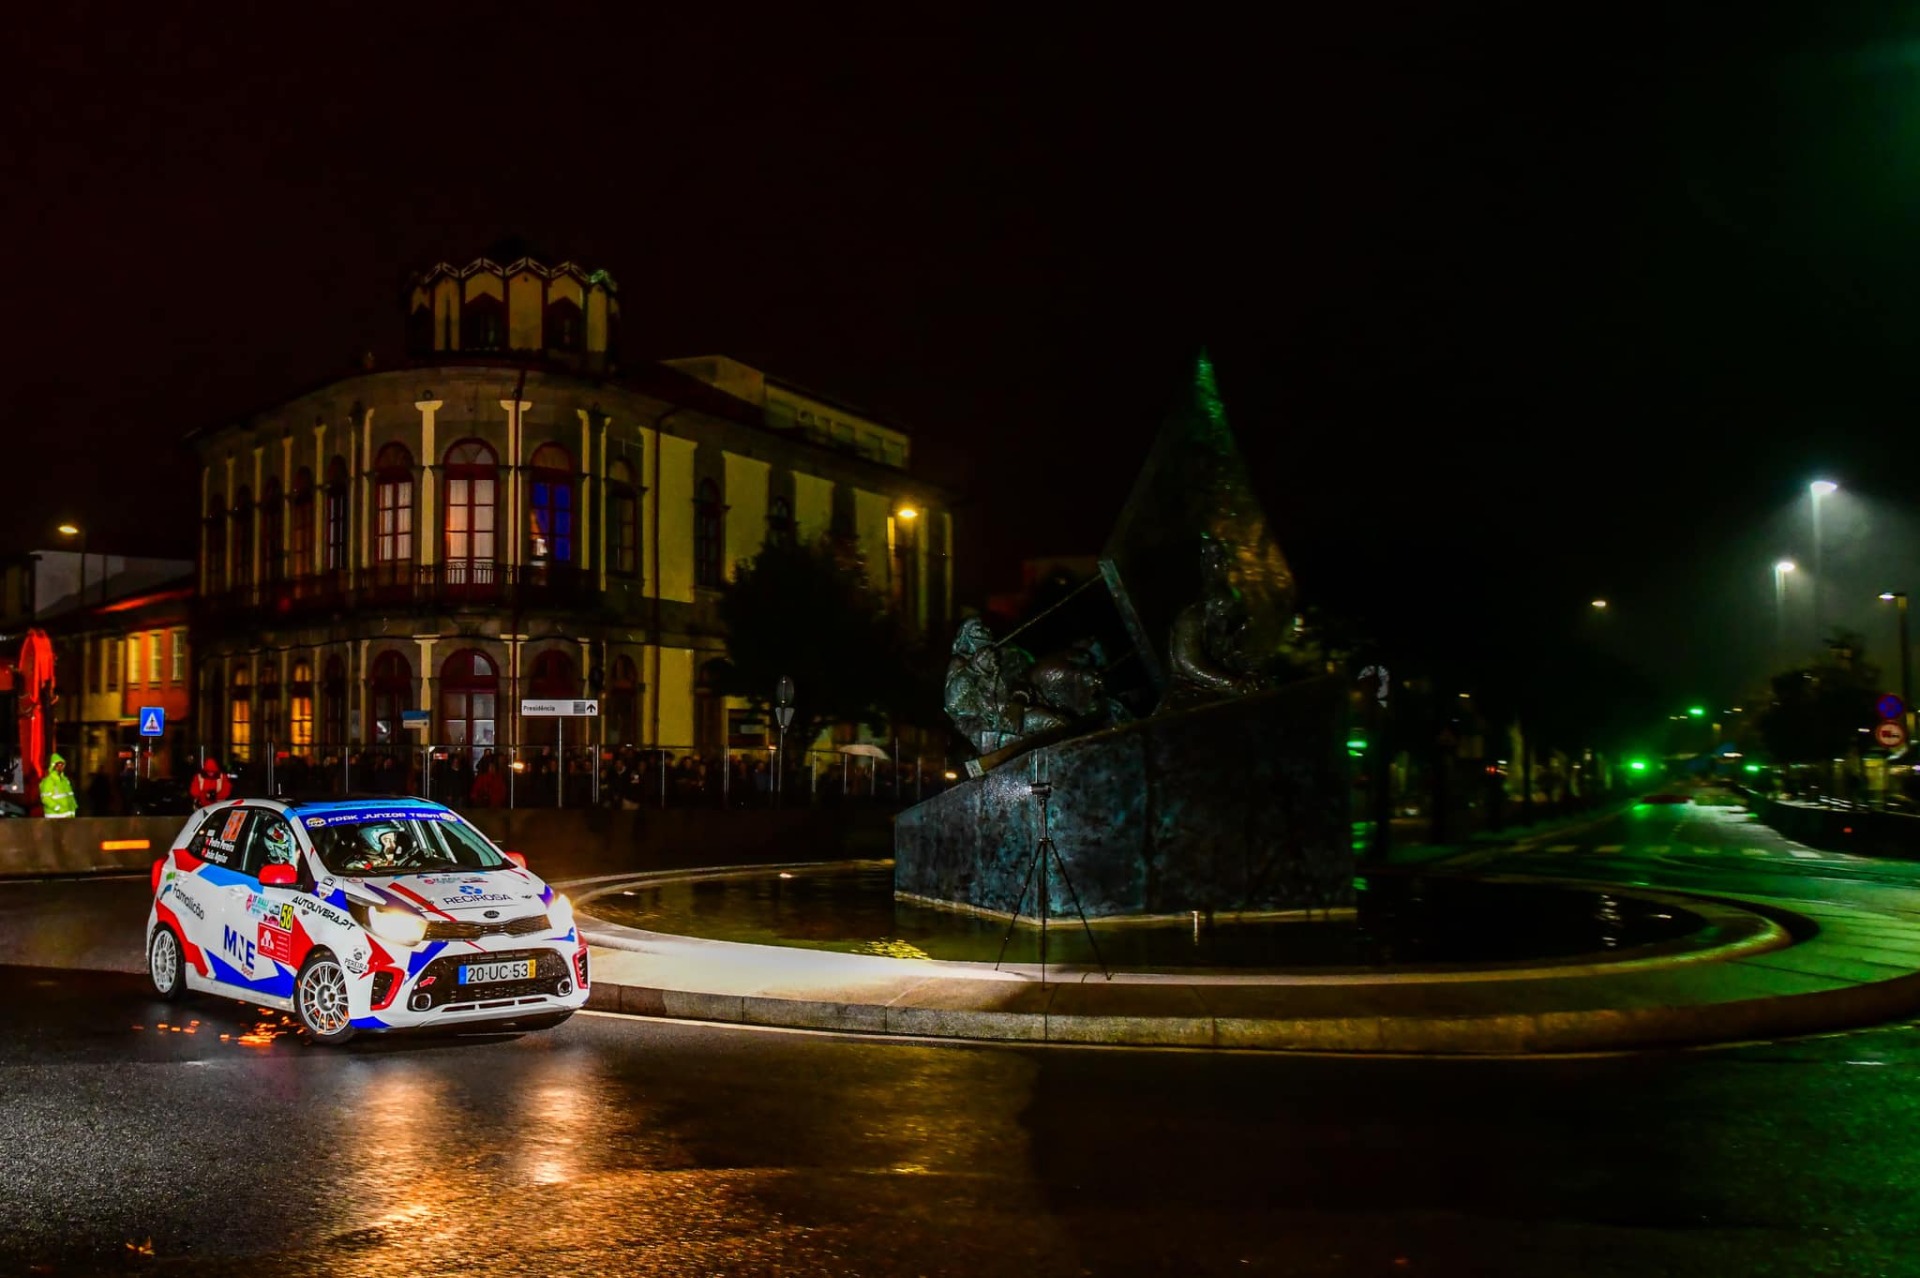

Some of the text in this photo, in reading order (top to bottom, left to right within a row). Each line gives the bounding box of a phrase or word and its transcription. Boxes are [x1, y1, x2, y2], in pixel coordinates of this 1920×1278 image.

[523, 704, 556, 712] Presidência
[173, 882, 205, 920] Famalicão
[443, 893, 513, 905] RECIROSA
[280, 904, 294, 930] 58
